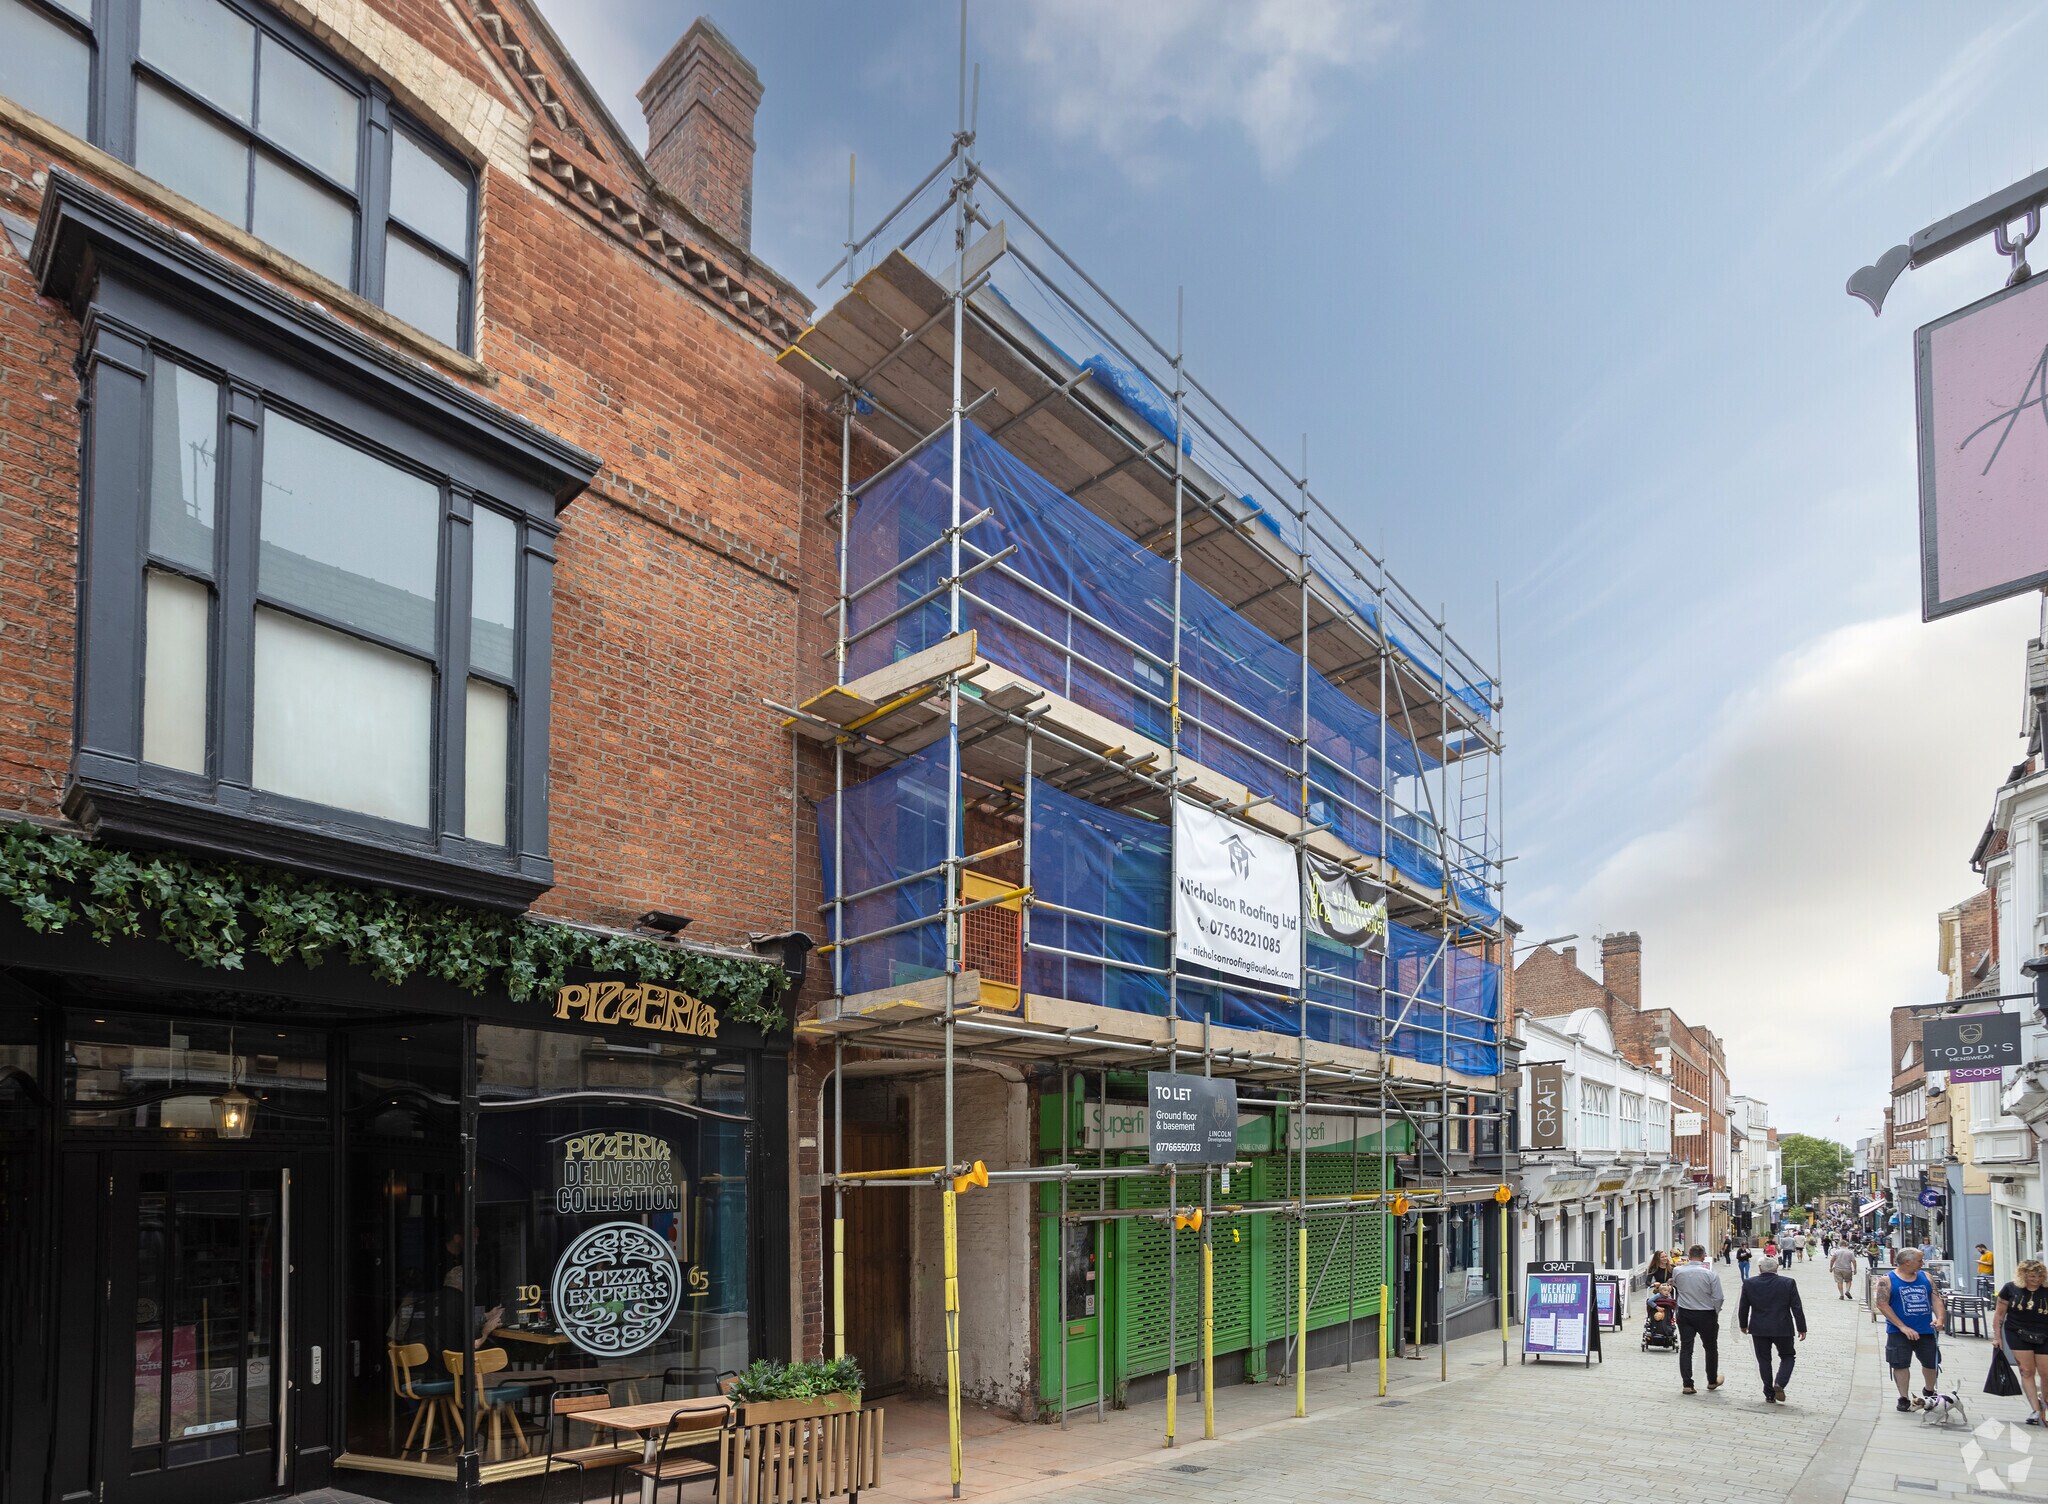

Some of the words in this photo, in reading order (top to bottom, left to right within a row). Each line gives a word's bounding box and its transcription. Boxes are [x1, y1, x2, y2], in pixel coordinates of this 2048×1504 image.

[1180, 877, 1236, 912] Nicholson
[1240, 899, 1279, 929] Roofing
[1282, 913, 1297, 931] Ltd
[1210, 919, 1281, 954] 07563221085
[1193, 946, 1294, 980] nicholsonroofing@outlook.com
[553, 981, 720, 1038] PIZZERIA
[1931, 1042, 2014, 1057] TODD'S
[1949, 1054, 1994, 1062] MENSWEAR
[1955, 1067, 2001, 1077] Scope
[1155, 1086, 1171, 1100] TO
[1173, 1088, 1192, 1101] LET
[1156, 1110, 1182, 1120] Ground
[1182, 1111, 1198, 1121] floor
[1537, 1077, 1556, 1137] CRAFT
[1092, 1109, 1144, 1138] Superfi
[1156, 1121, 1161, 1130] &
[1163, 1121, 1195, 1131] basement
[1208, 1130, 1232, 1138] LINCOLN
[1293, 1121, 1325, 1143] Sperfi
[565, 1131, 671, 1161] PIZZERIA
[1156, 1142, 1201, 1152] 07766550733
[564, 1161, 656, 1187] DELIVERY
[656, 1161, 672, 1185] &
[556, 1185, 679, 1214] COLLECTION
[1543, 1262, 1576, 1271] CRAFT
[588, 1267, 651, 1288] PIZZA
[689, 1266, 709, 1290] 65
[568, 1282, 668, 1307] EXPRESS
[1540, 1283, 1577, 1294] WEEKEND
[1540, 1293, 1576, 1303] WARMUP
